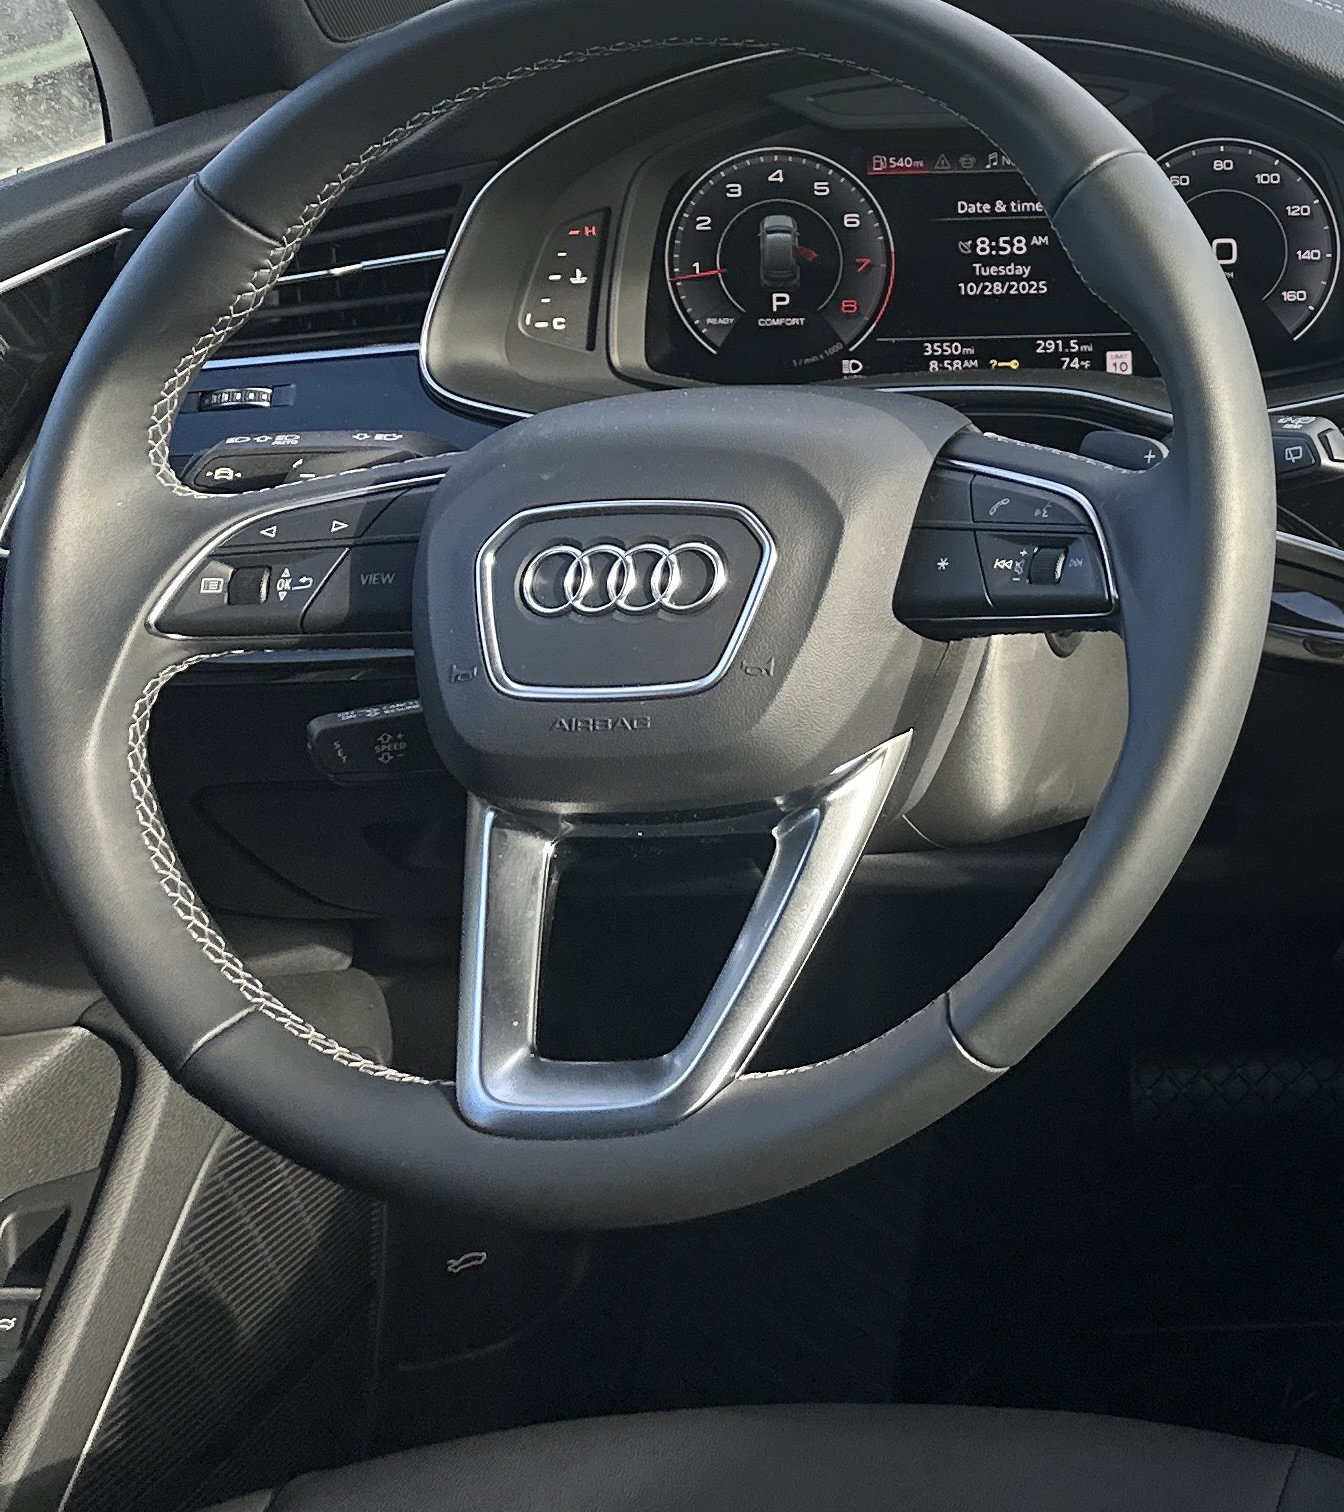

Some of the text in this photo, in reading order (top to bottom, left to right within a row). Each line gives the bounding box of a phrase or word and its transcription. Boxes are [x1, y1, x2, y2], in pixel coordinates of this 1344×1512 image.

[1213, 159, 1234, 171] 80
[768, 169, 784, 183] 4
[1170, 175, 1190, 187] 60
[1255, 172, 1281, 185] 100
[726, 183, 742, 198] 3
[814, 181, 830, 196] 5
[957, 198, 1044, 214] Date & time
[1286, 204, 1311, 217] 120
[696, 216, 712, 230] 2
[844, 214, 860, 228] 6
[584, 226, 597, 237] H
[975, 235, 1049, 256] 8:58 AM
[1296, 249, 1321, 262] 140
[692, 262, 701, 275] 1
[856, 258, 872, 273] 7
[972, 262, 1031, 278] Tuesday
[958, 280, 1049, 296] 10/28/2025
[772, 292, 790, 312] P
[1282, 290, 1307, 302] 160
[842, 299, 859, 313] 8
[552, 317, 566, 330] C
[706, 317, 735, 326] READY
[757, 317, 806, 327] COMFORT
[1110, 361, 1128, 372] 10
[277, 578, 292, 591] OK
[359, 573, 396, 586] VIEW
[549, 717, 652, 731] AIRBAG
